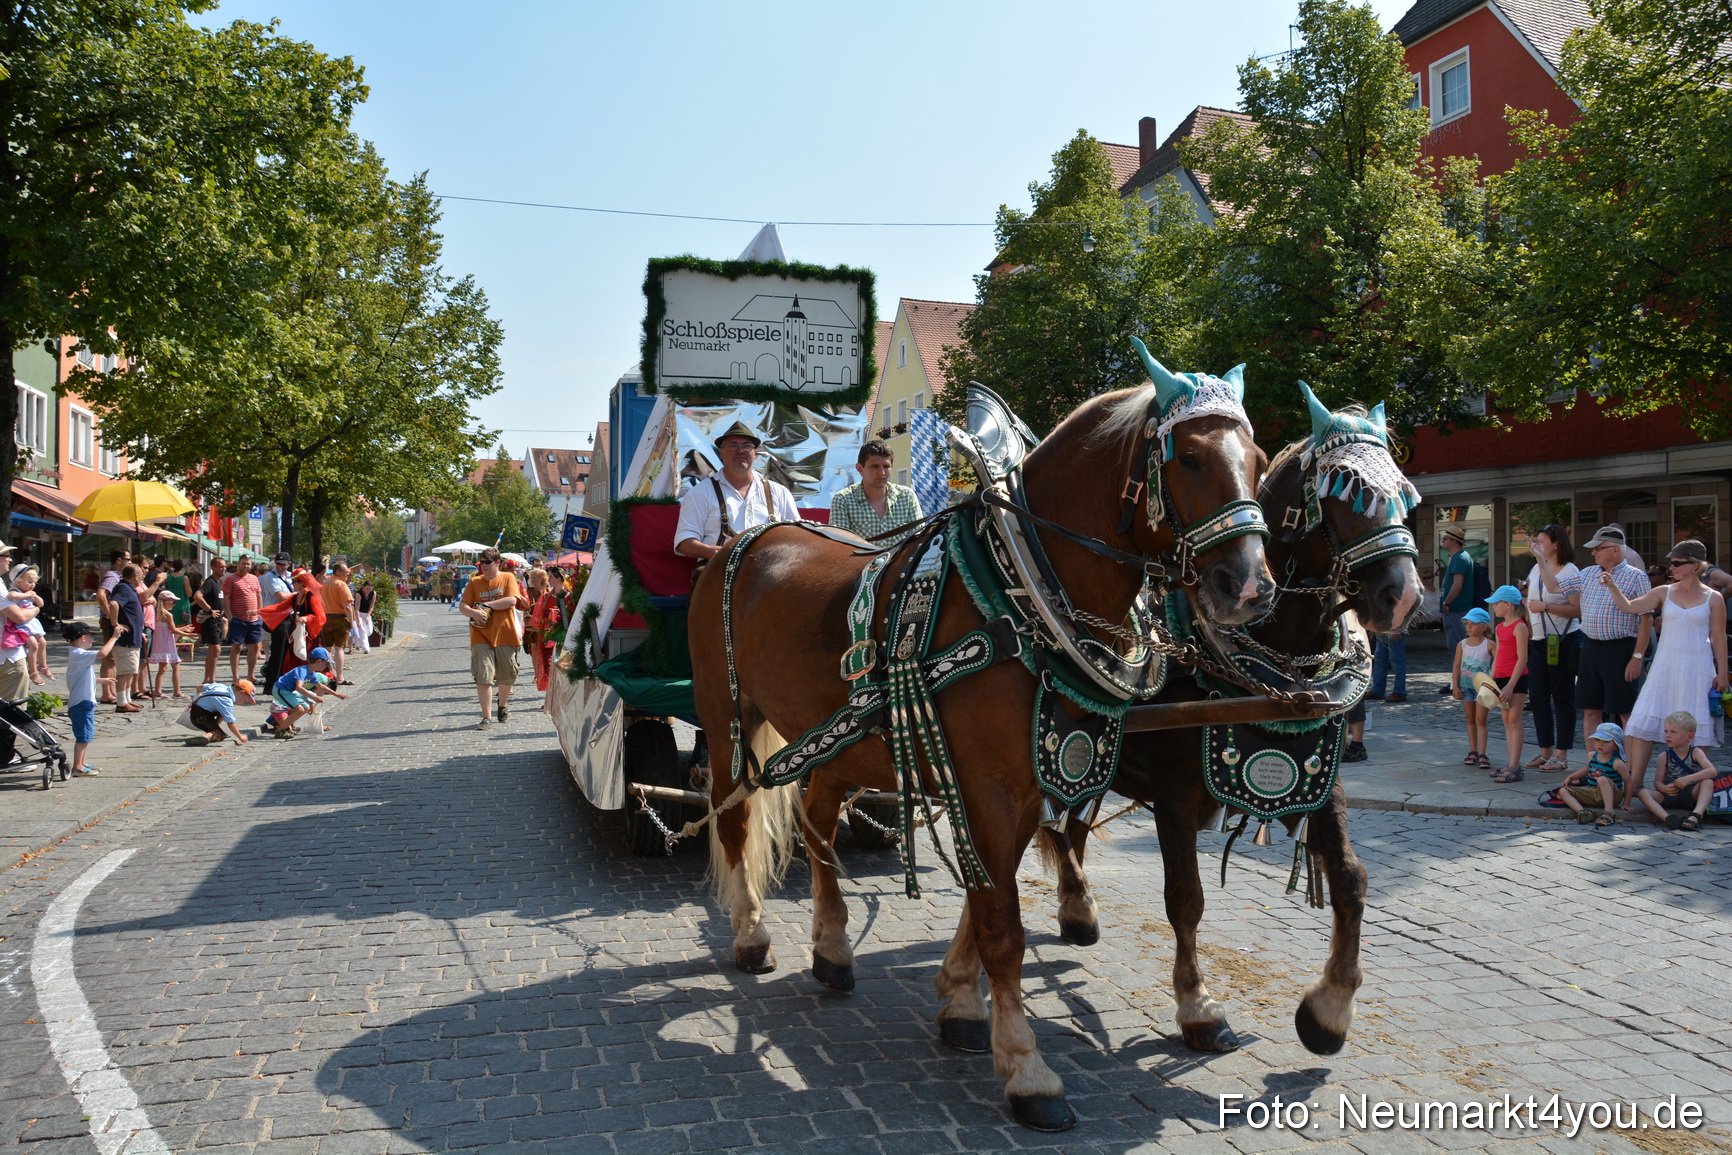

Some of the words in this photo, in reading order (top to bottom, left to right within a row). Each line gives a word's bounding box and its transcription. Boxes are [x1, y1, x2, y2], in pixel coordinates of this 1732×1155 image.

[663, 319, 782, 343] Schloßspiele
[668, 338, 731, 352] Neumarkt
[1447, 440, 1514, 467] JOSEF
[252, 506, 260, 518] P
